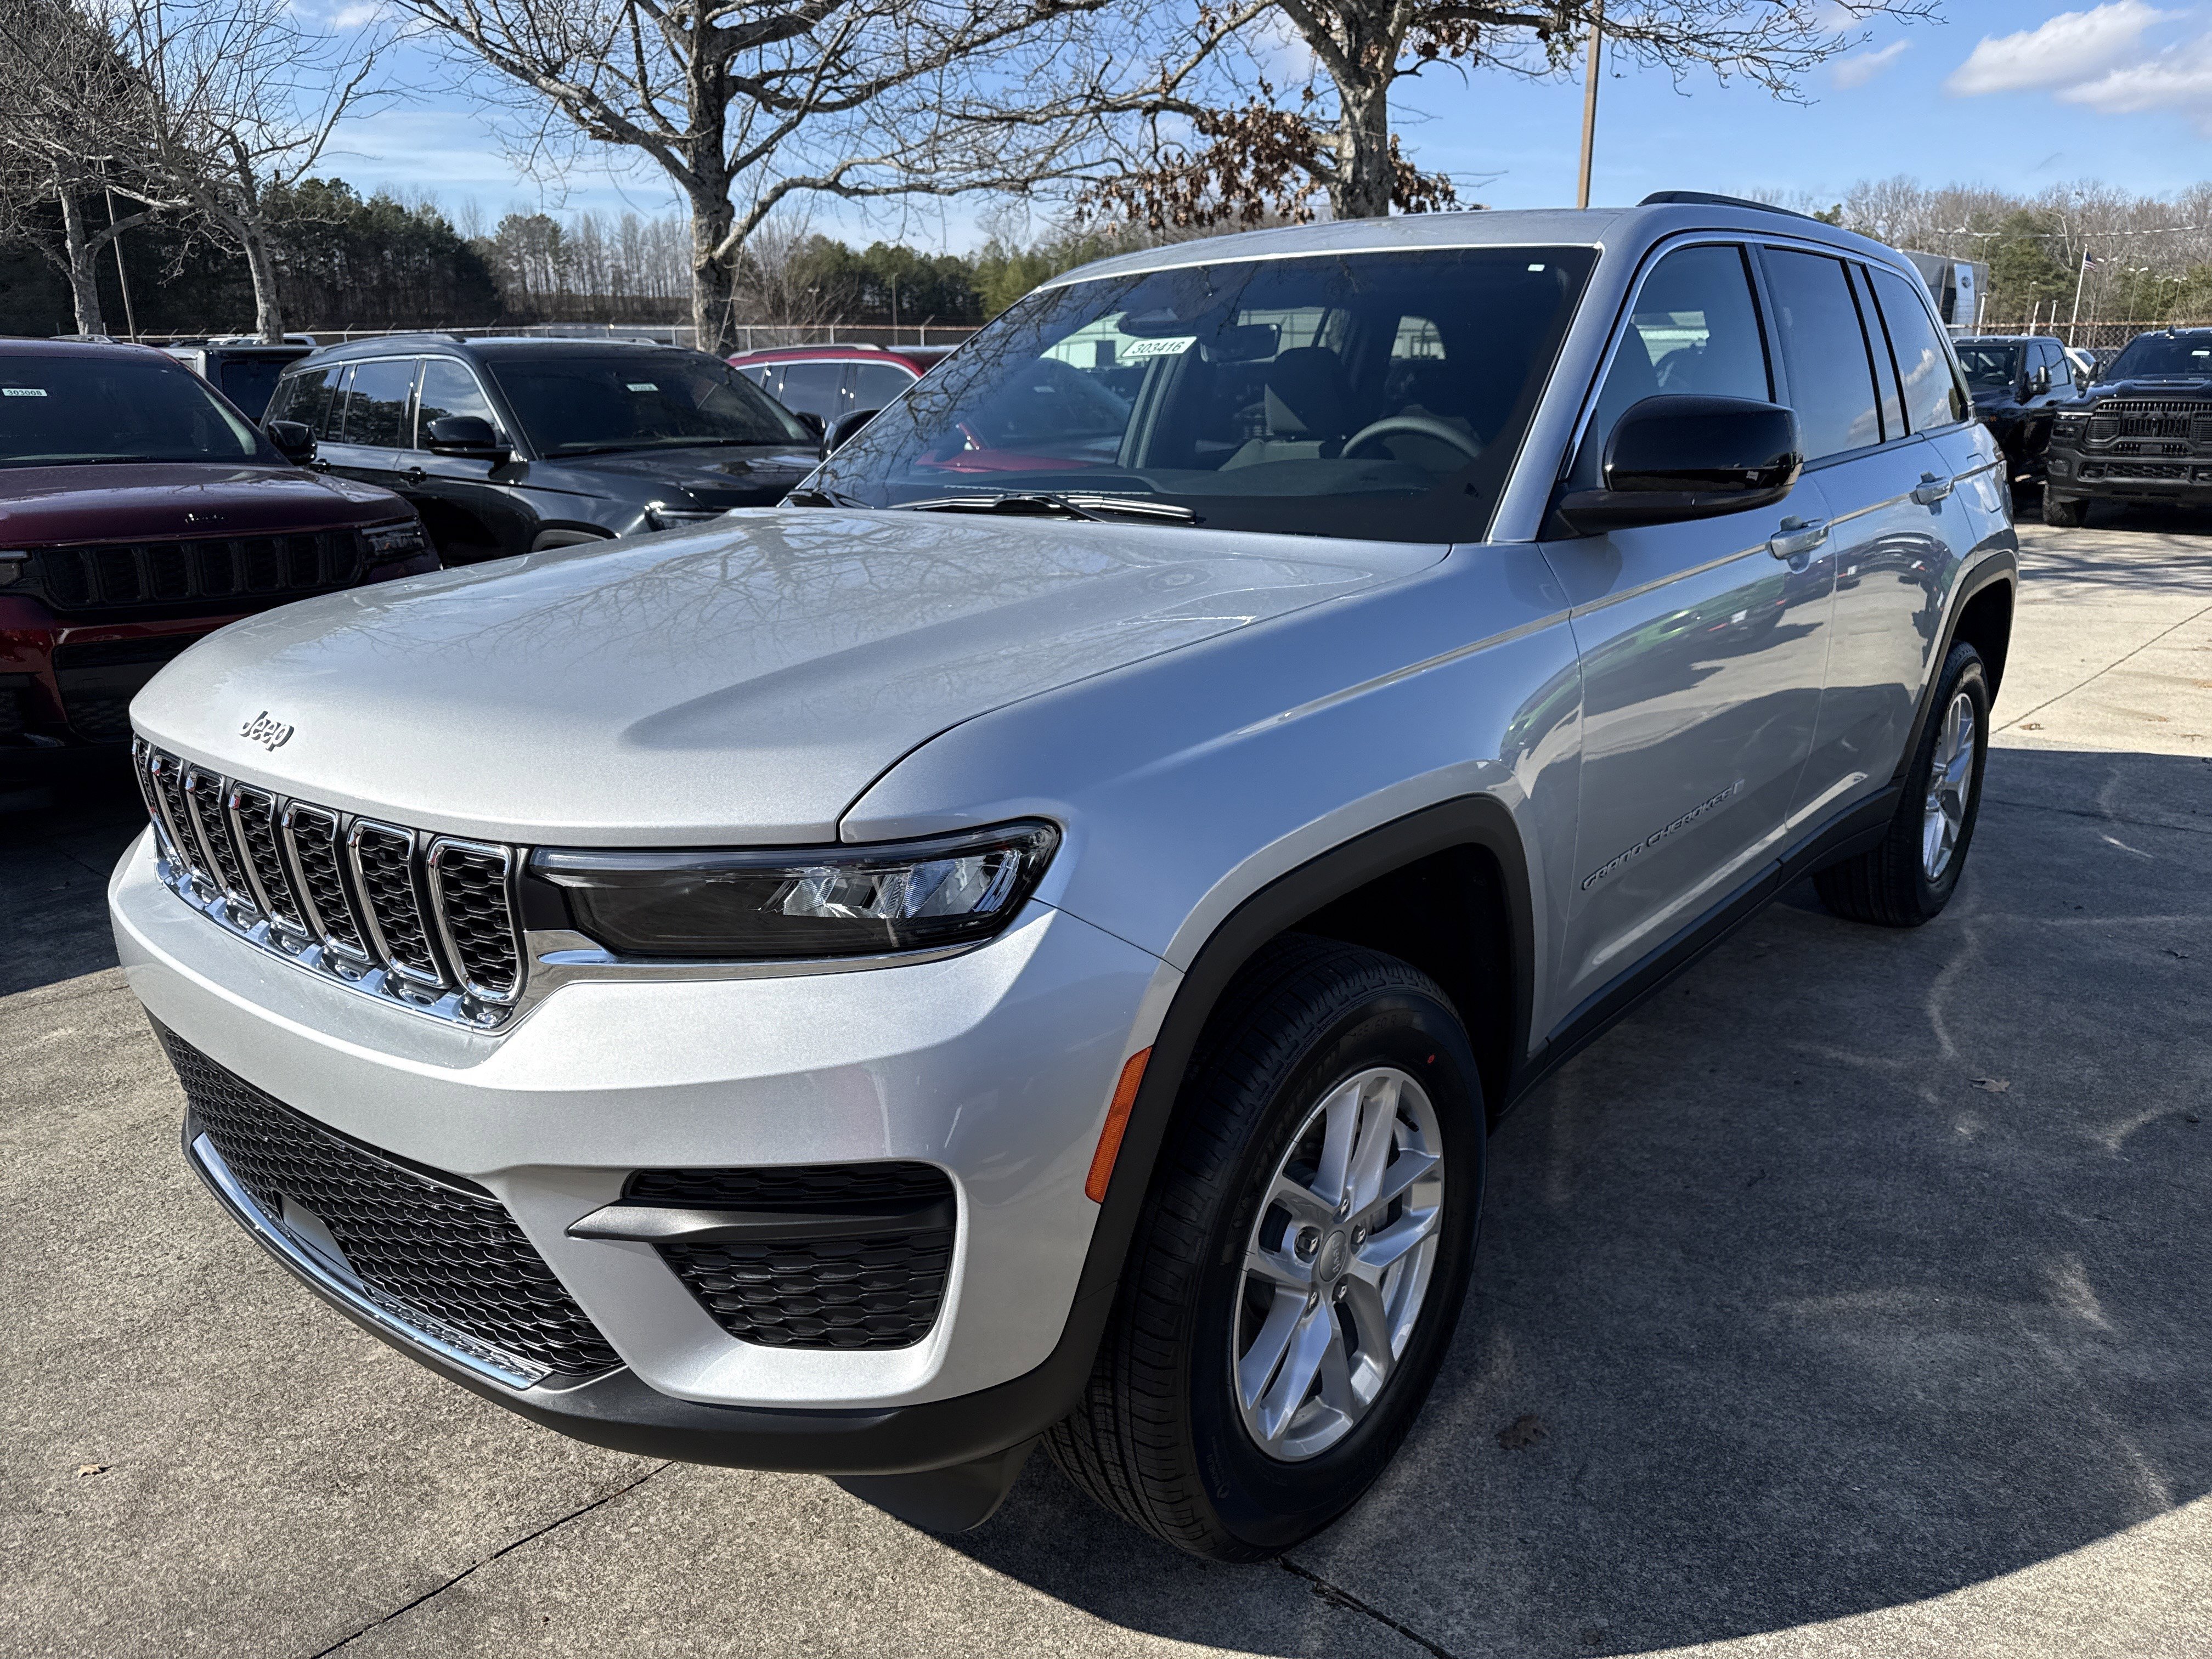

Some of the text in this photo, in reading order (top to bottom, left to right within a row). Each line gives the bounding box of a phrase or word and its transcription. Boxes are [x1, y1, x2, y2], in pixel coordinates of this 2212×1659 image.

[1132, 341, 1185, 354] 303416
[239, 710, 295, 752] Jeep
[1581, 786, 1733, 890] GRAND CHEROKEE
[1254, 1051, 1336, 1186] MICHELIN
